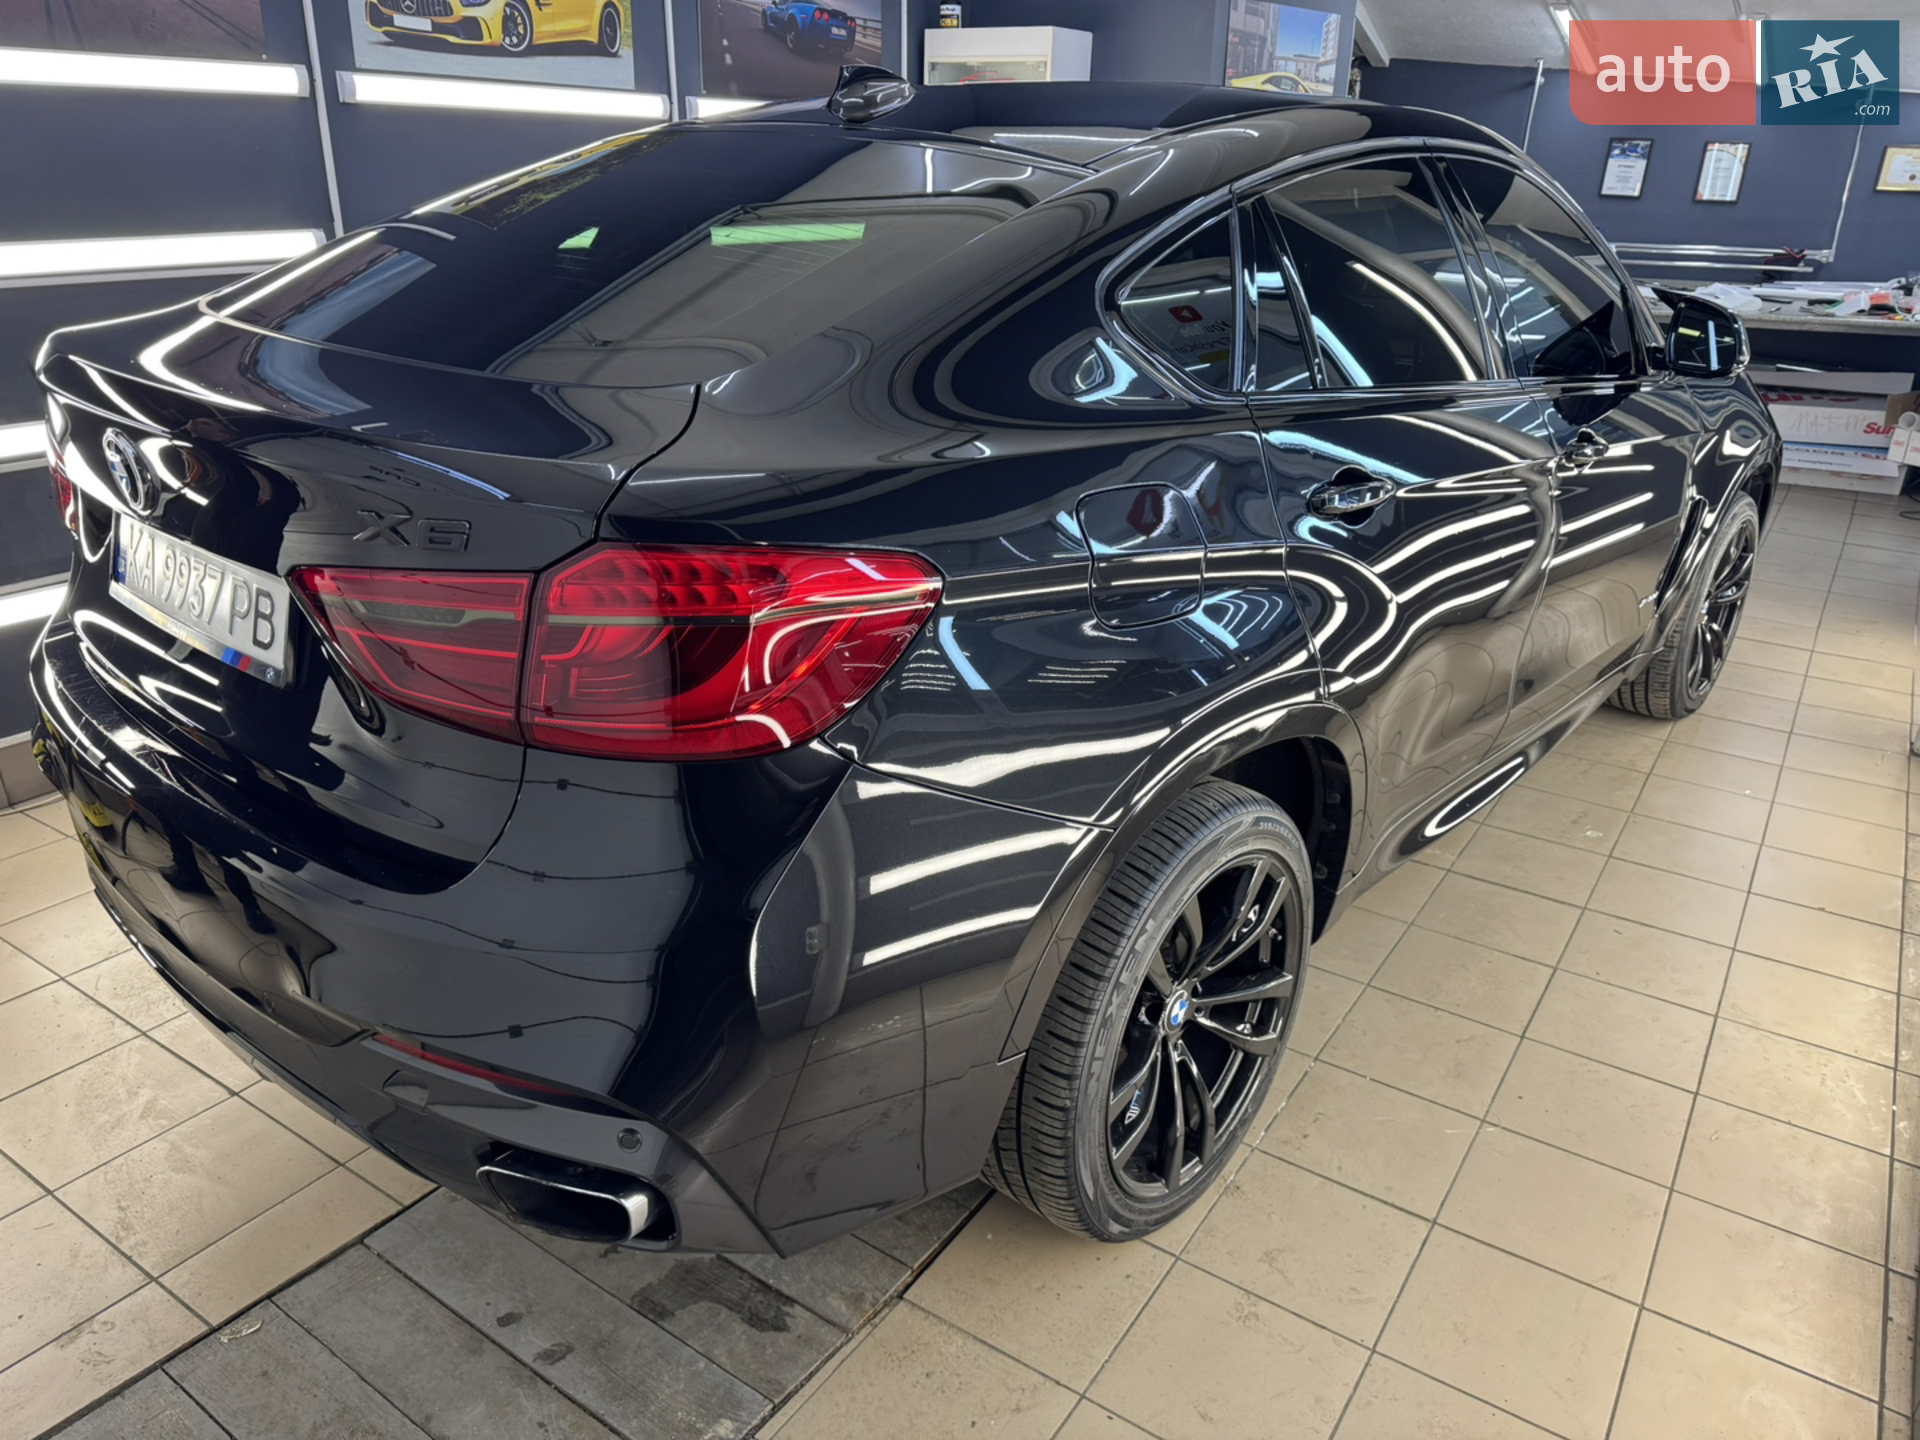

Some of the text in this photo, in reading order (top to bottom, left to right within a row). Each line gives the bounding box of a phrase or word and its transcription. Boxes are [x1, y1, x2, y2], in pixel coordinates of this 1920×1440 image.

[127, 522, 276, 651] KA 9937 PB
[352, 508, 472, 553] X6
[1085, 917, 1158, 1096] NEXEN
